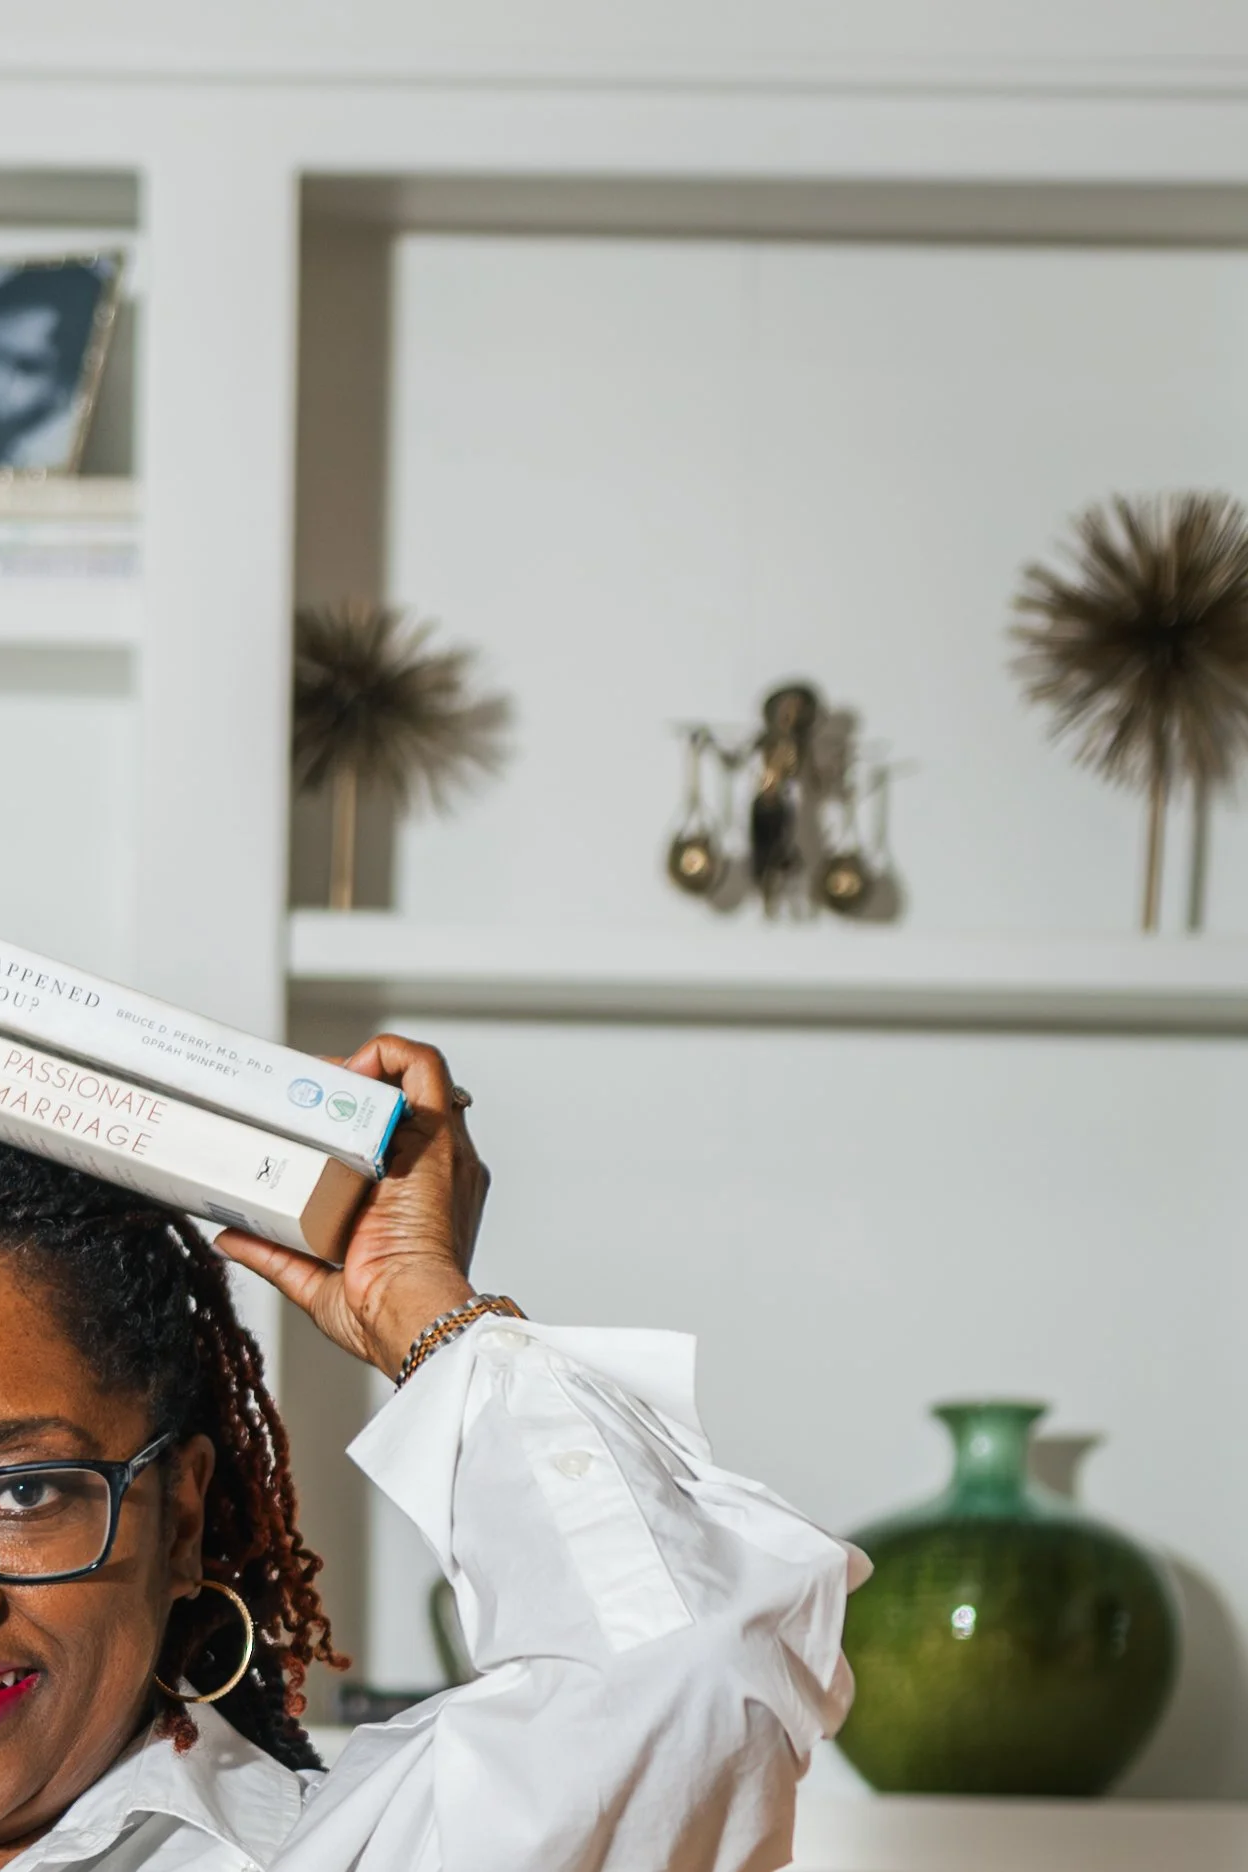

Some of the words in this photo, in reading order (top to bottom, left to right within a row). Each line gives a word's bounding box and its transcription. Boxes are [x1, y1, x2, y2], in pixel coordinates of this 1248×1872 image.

[116, 1008, 155, 1030] BRUCE
[158, 1024, 169, 1036] D.
[173, 1031, 213, 1053] PERRY,
[246, 1058, 275, 1075] Ph.D.
[141, 1035, 181, 1057] OPRAH
[186, 1051, 240, 1078] WINFREY
[3, 1049, 168, 1124] PASSIONATE
